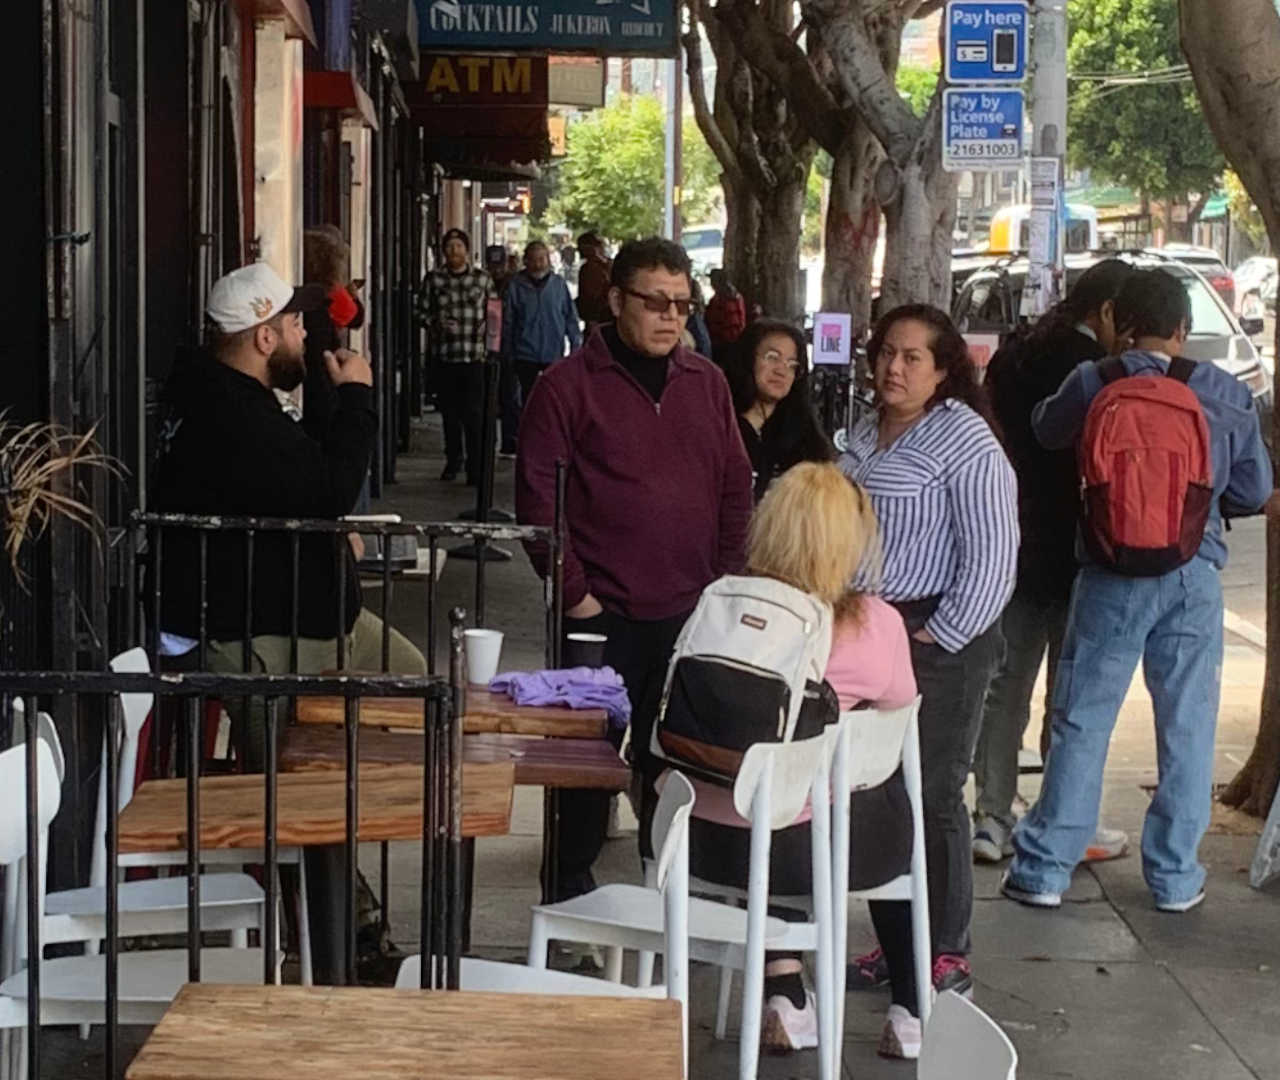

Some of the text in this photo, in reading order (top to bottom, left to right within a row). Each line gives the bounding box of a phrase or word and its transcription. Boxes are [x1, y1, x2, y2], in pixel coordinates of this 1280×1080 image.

[952, 9, 1023, 29] Pay here
[425, 57, 533, 93] ATM
[950, 93, 1001, 112] Pay by
[950, 110, 1006, 124] License
[950, 124, 989, 138] Plate
[952, 142, 1016, 156] 21631003
